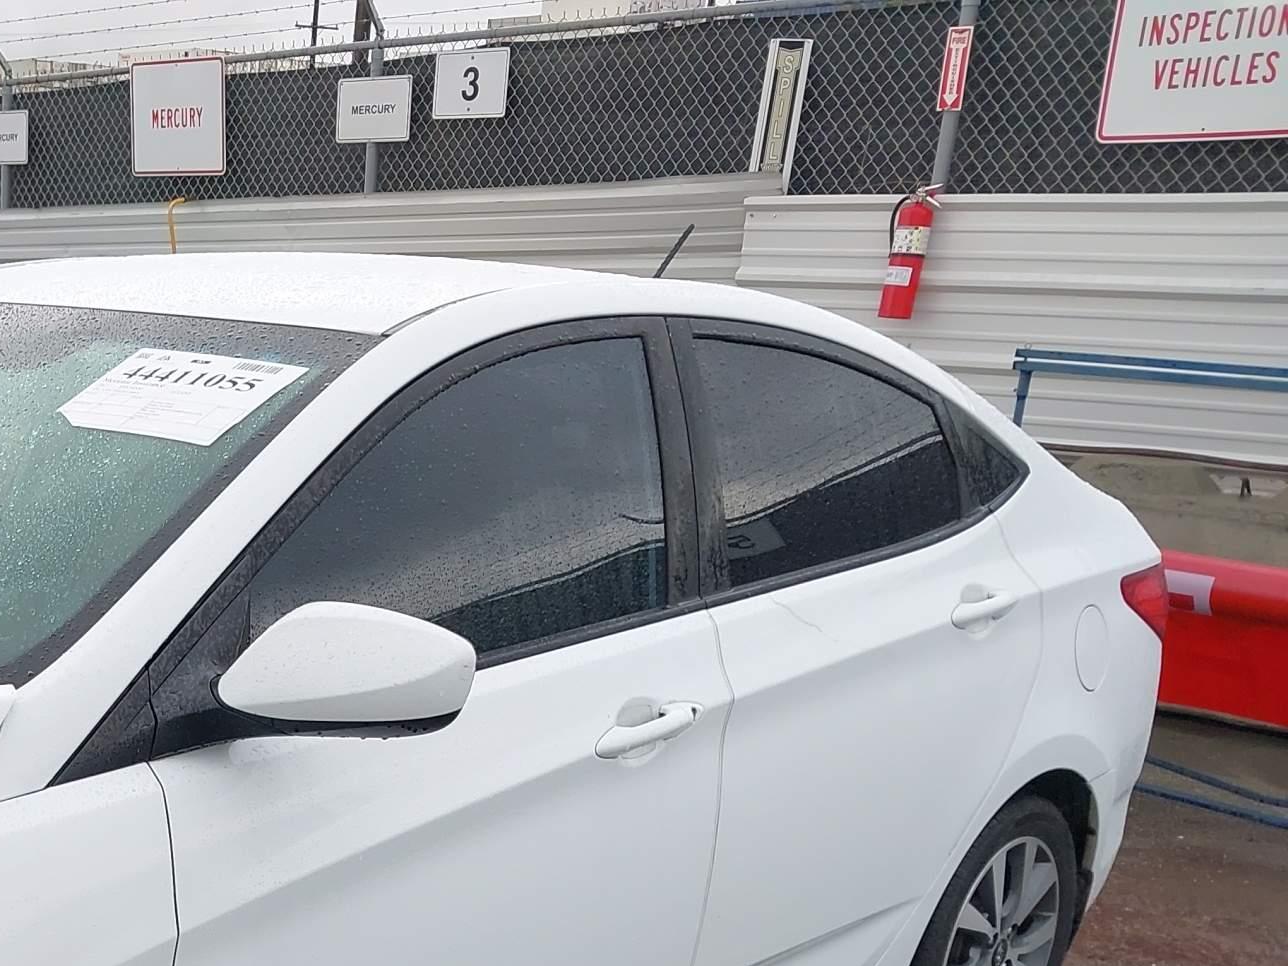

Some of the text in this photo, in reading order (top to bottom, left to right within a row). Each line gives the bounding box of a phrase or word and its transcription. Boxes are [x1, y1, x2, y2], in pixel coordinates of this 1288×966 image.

[461, 66, 480, 102] 3
[1154, 51, 1280, 90] VEHICLES
[151, 106, 203, 129] MERCURY
[351, 103, 396, 117] MERCURY
[768, 55, 795, 161] SPILL
[123, 365, 263, 392] 44411055
